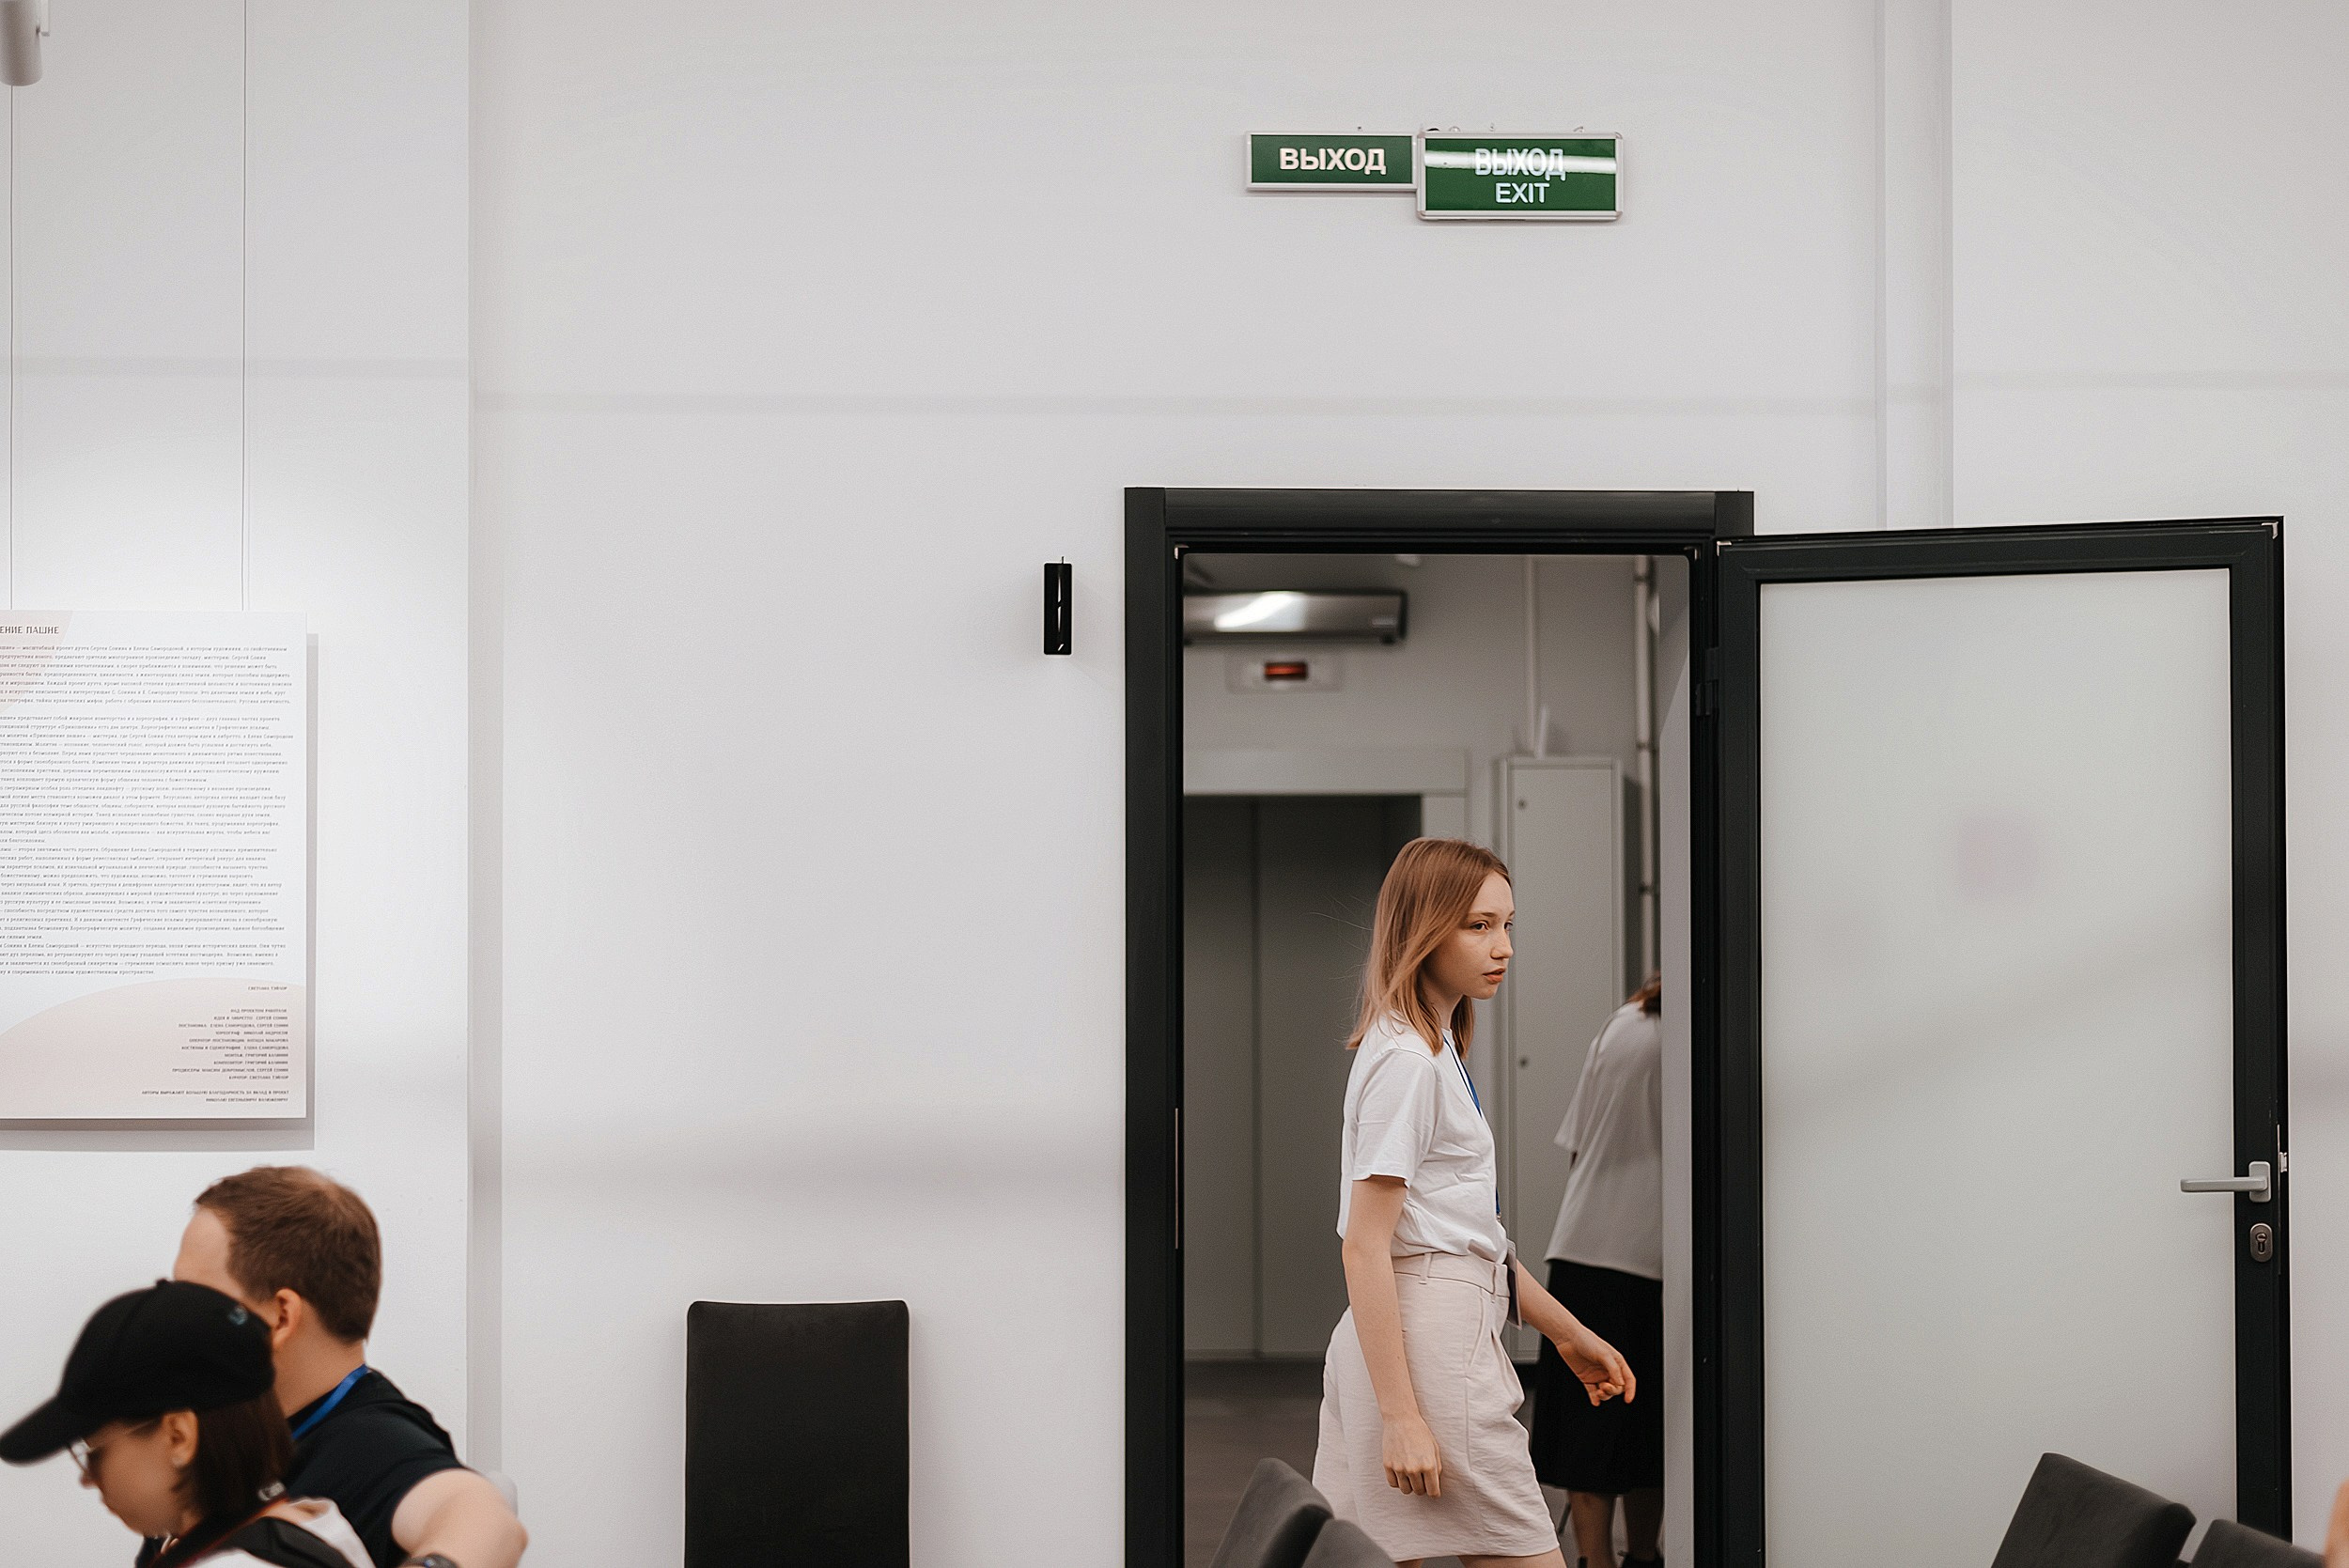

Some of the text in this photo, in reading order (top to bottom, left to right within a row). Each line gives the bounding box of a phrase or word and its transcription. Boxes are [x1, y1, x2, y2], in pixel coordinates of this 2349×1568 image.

[1279, 147, 1386, 175] ВЫХОД
[1474, 147, 1566, 180] ВЫХОД
[1495, 182, 1550, 204] EXIT
[26, 626, 59, 634] ПАШНЕ
